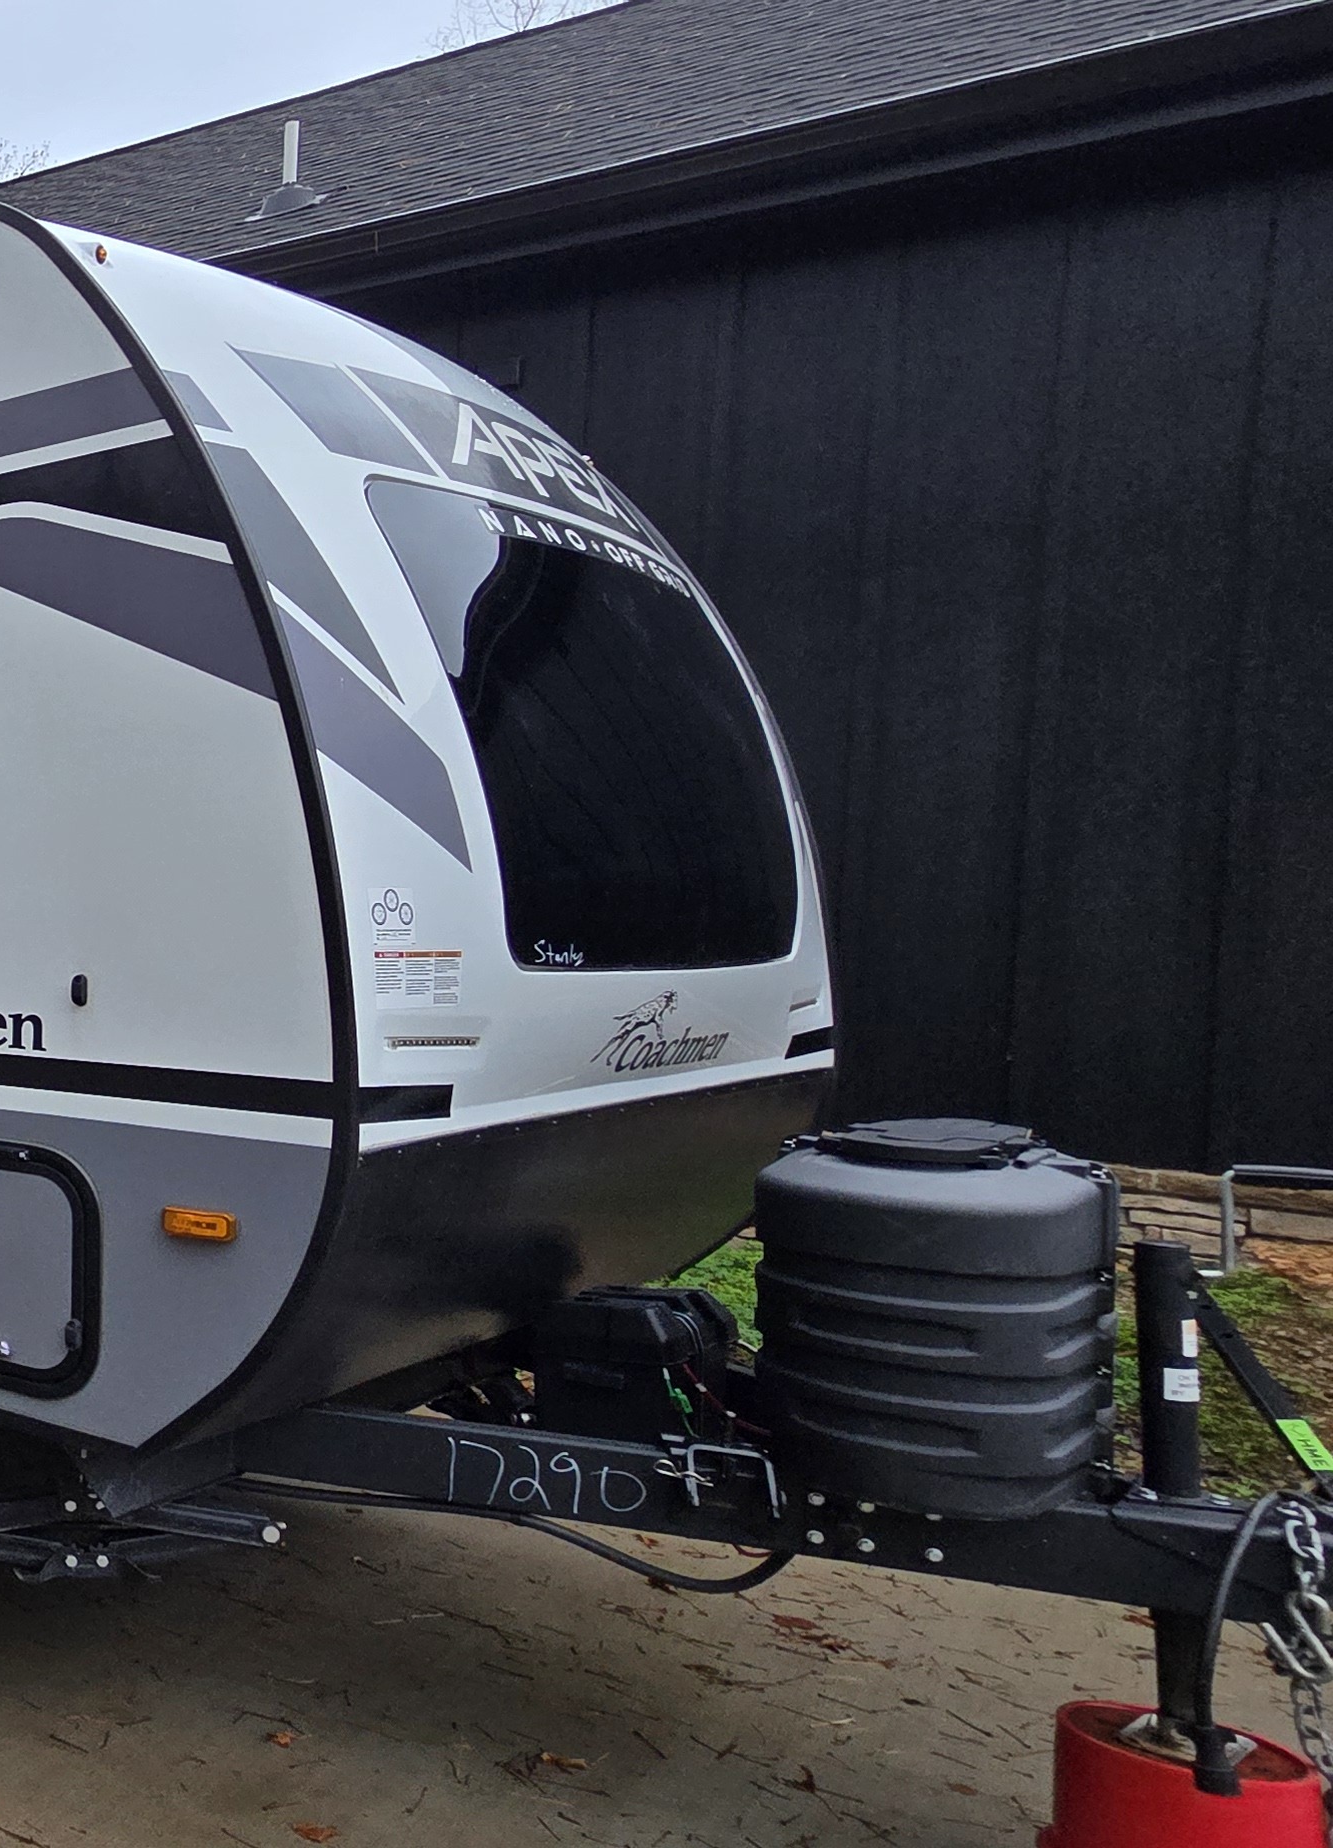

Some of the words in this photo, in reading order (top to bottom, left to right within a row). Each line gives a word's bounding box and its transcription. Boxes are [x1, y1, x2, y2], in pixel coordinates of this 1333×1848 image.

[452, 402, 639, 532] APEX
[478, 508, 587, 551] NANO
[603, 541, 645, 573] OFF
[614, 1026, 730, 1072] Coachmen
[447, 1436, 647, 1513] 17290
